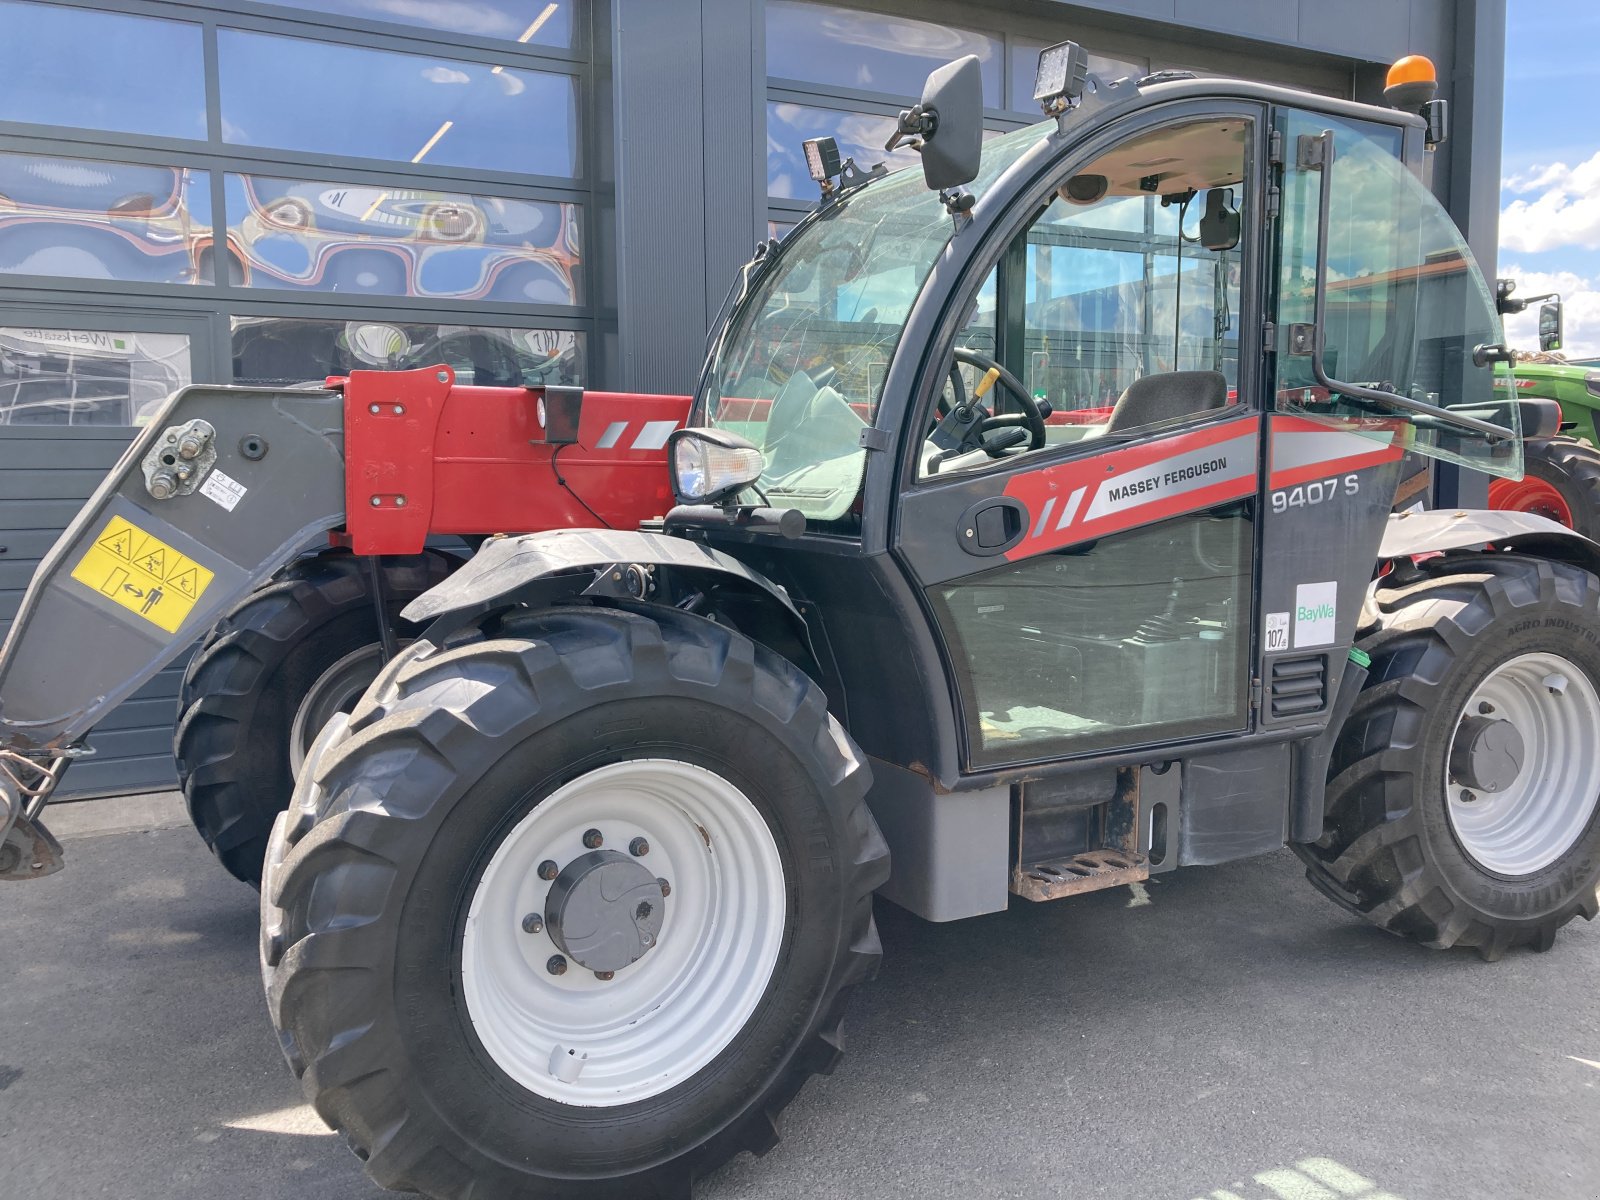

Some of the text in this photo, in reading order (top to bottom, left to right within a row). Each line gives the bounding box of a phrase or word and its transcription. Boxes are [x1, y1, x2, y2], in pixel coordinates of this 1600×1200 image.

[1108, 457, 1227, 502] MASSEY FERGUSON
[1271, 474, 1360, 514] 9407 S
[1298, 603, 1335, 622] BayWa
[1507, 620, 1541, 637] AGRO
[1267, 629, 1284, 649] 107
